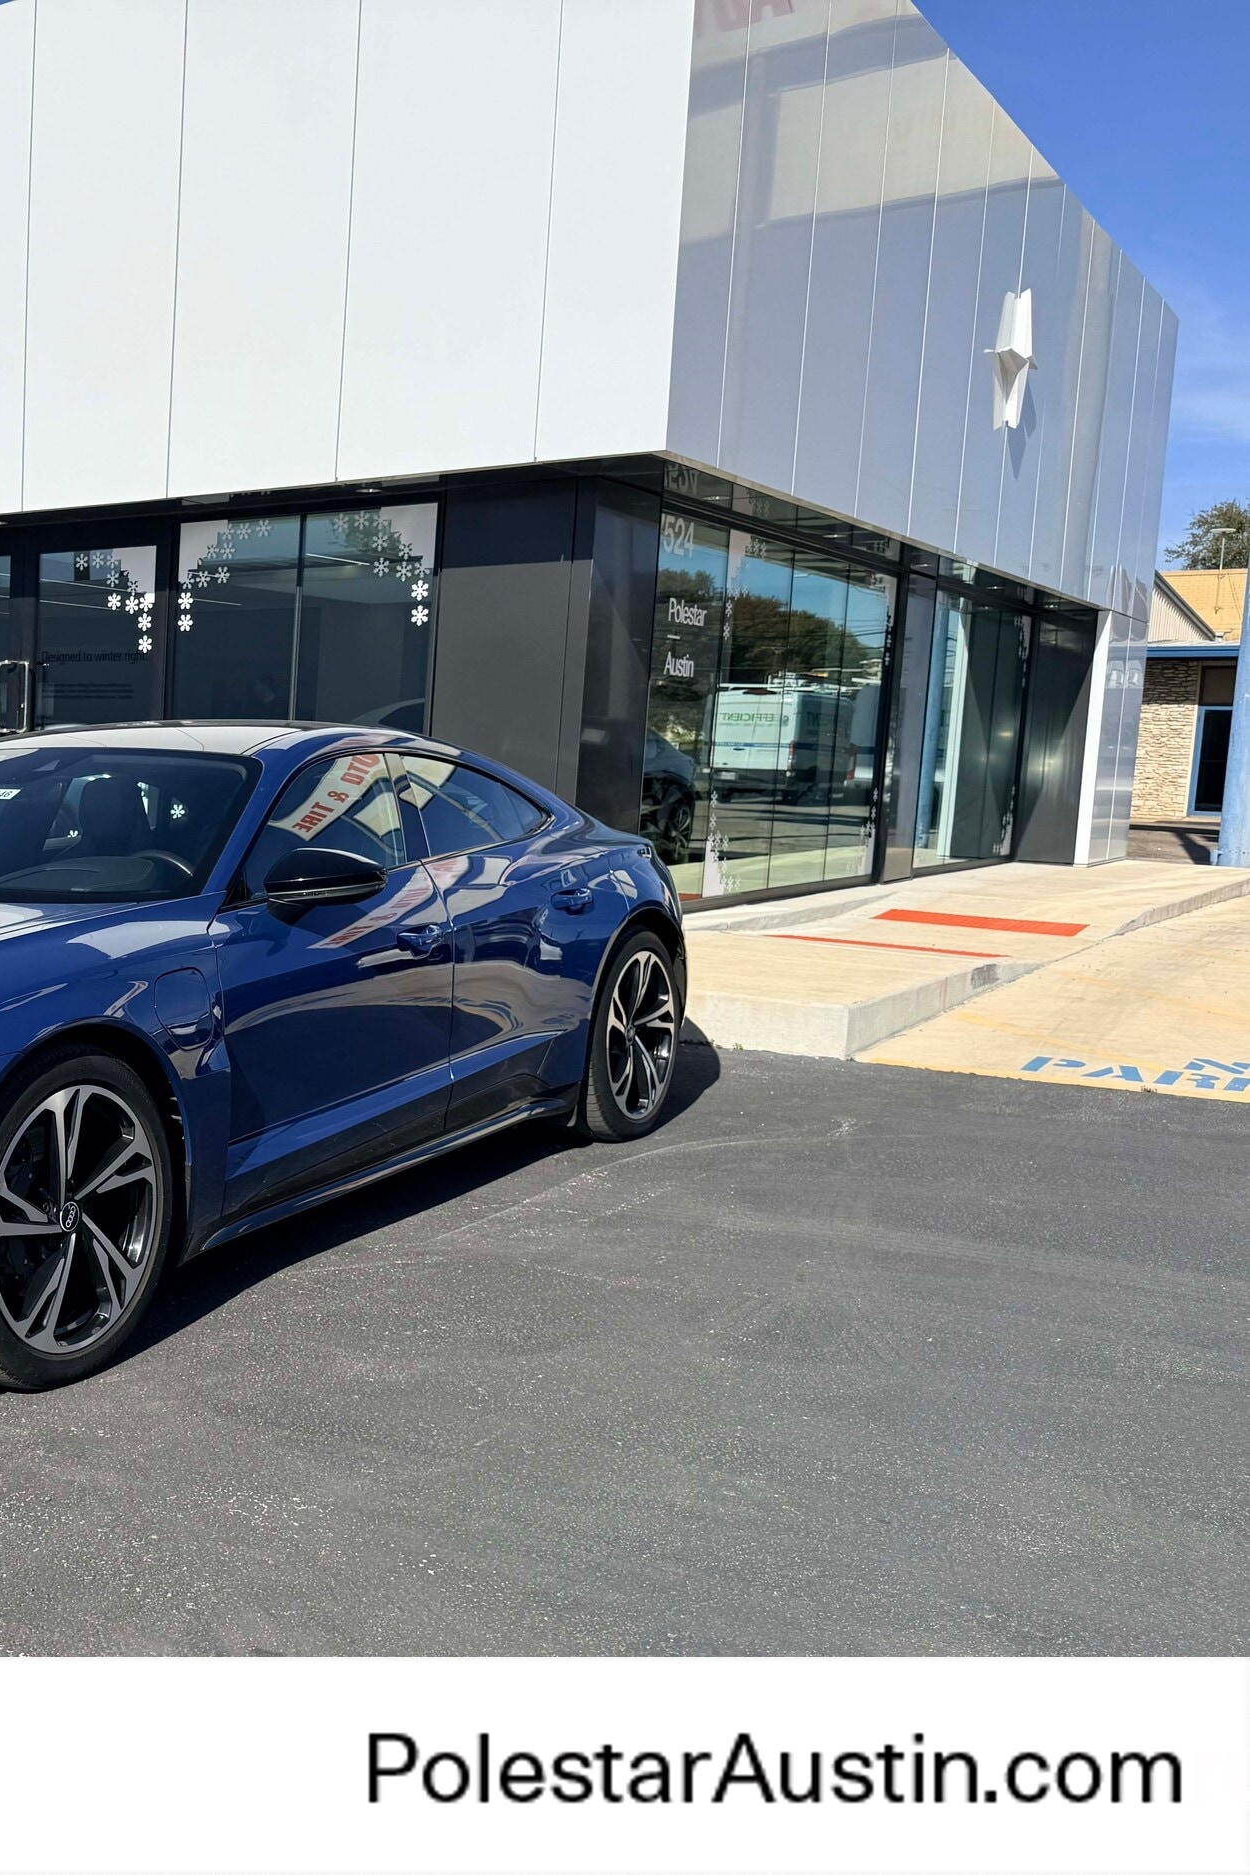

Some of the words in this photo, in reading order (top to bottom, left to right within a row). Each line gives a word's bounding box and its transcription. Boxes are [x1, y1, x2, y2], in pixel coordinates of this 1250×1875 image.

[668, 597, 707, 627] Polestar
[83, 651, 92, 662] to
[663, 651, 694, 678] Austin
